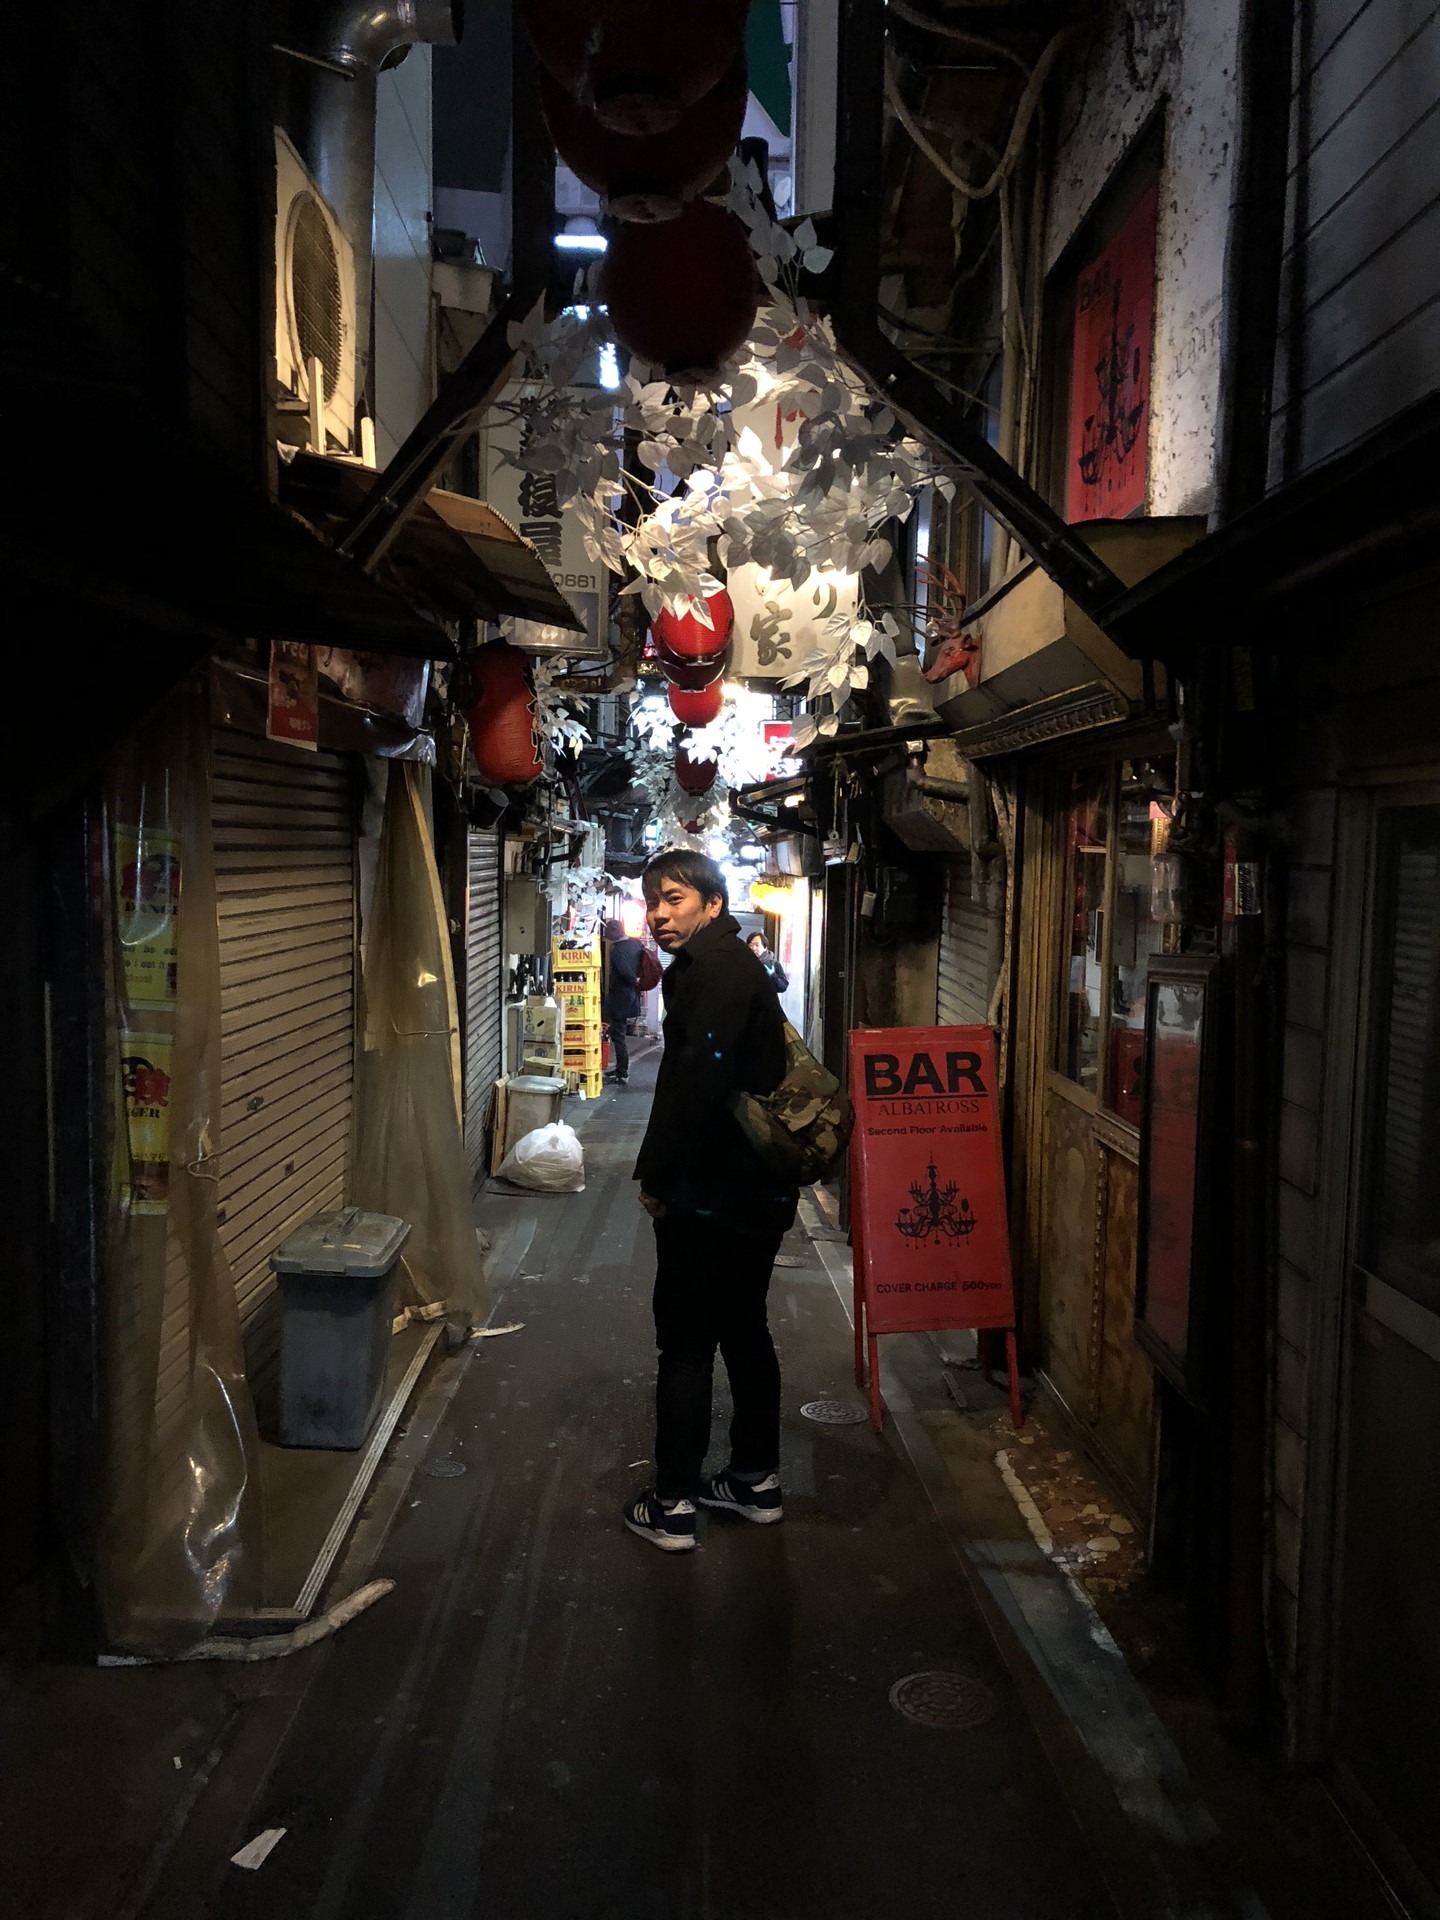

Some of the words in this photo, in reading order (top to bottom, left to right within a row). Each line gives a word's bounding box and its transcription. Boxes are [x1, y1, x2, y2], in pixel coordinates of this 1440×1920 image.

[561, 951, 590, 961] KIRIN
[556, 984, 585, 994] KIRIN
[864, 1052, 988, 1096] BAR
[878, 1100, 980, 1116] ALBATROSS
[868, 1125, 907, 1136] Second
[910, 1125, 936, 1135] Floor
[940, 1123, 988, 1134] Available
[876, 1283, 912, 1294] COVER
[914, 1281, 958, 1293] CHARGE
